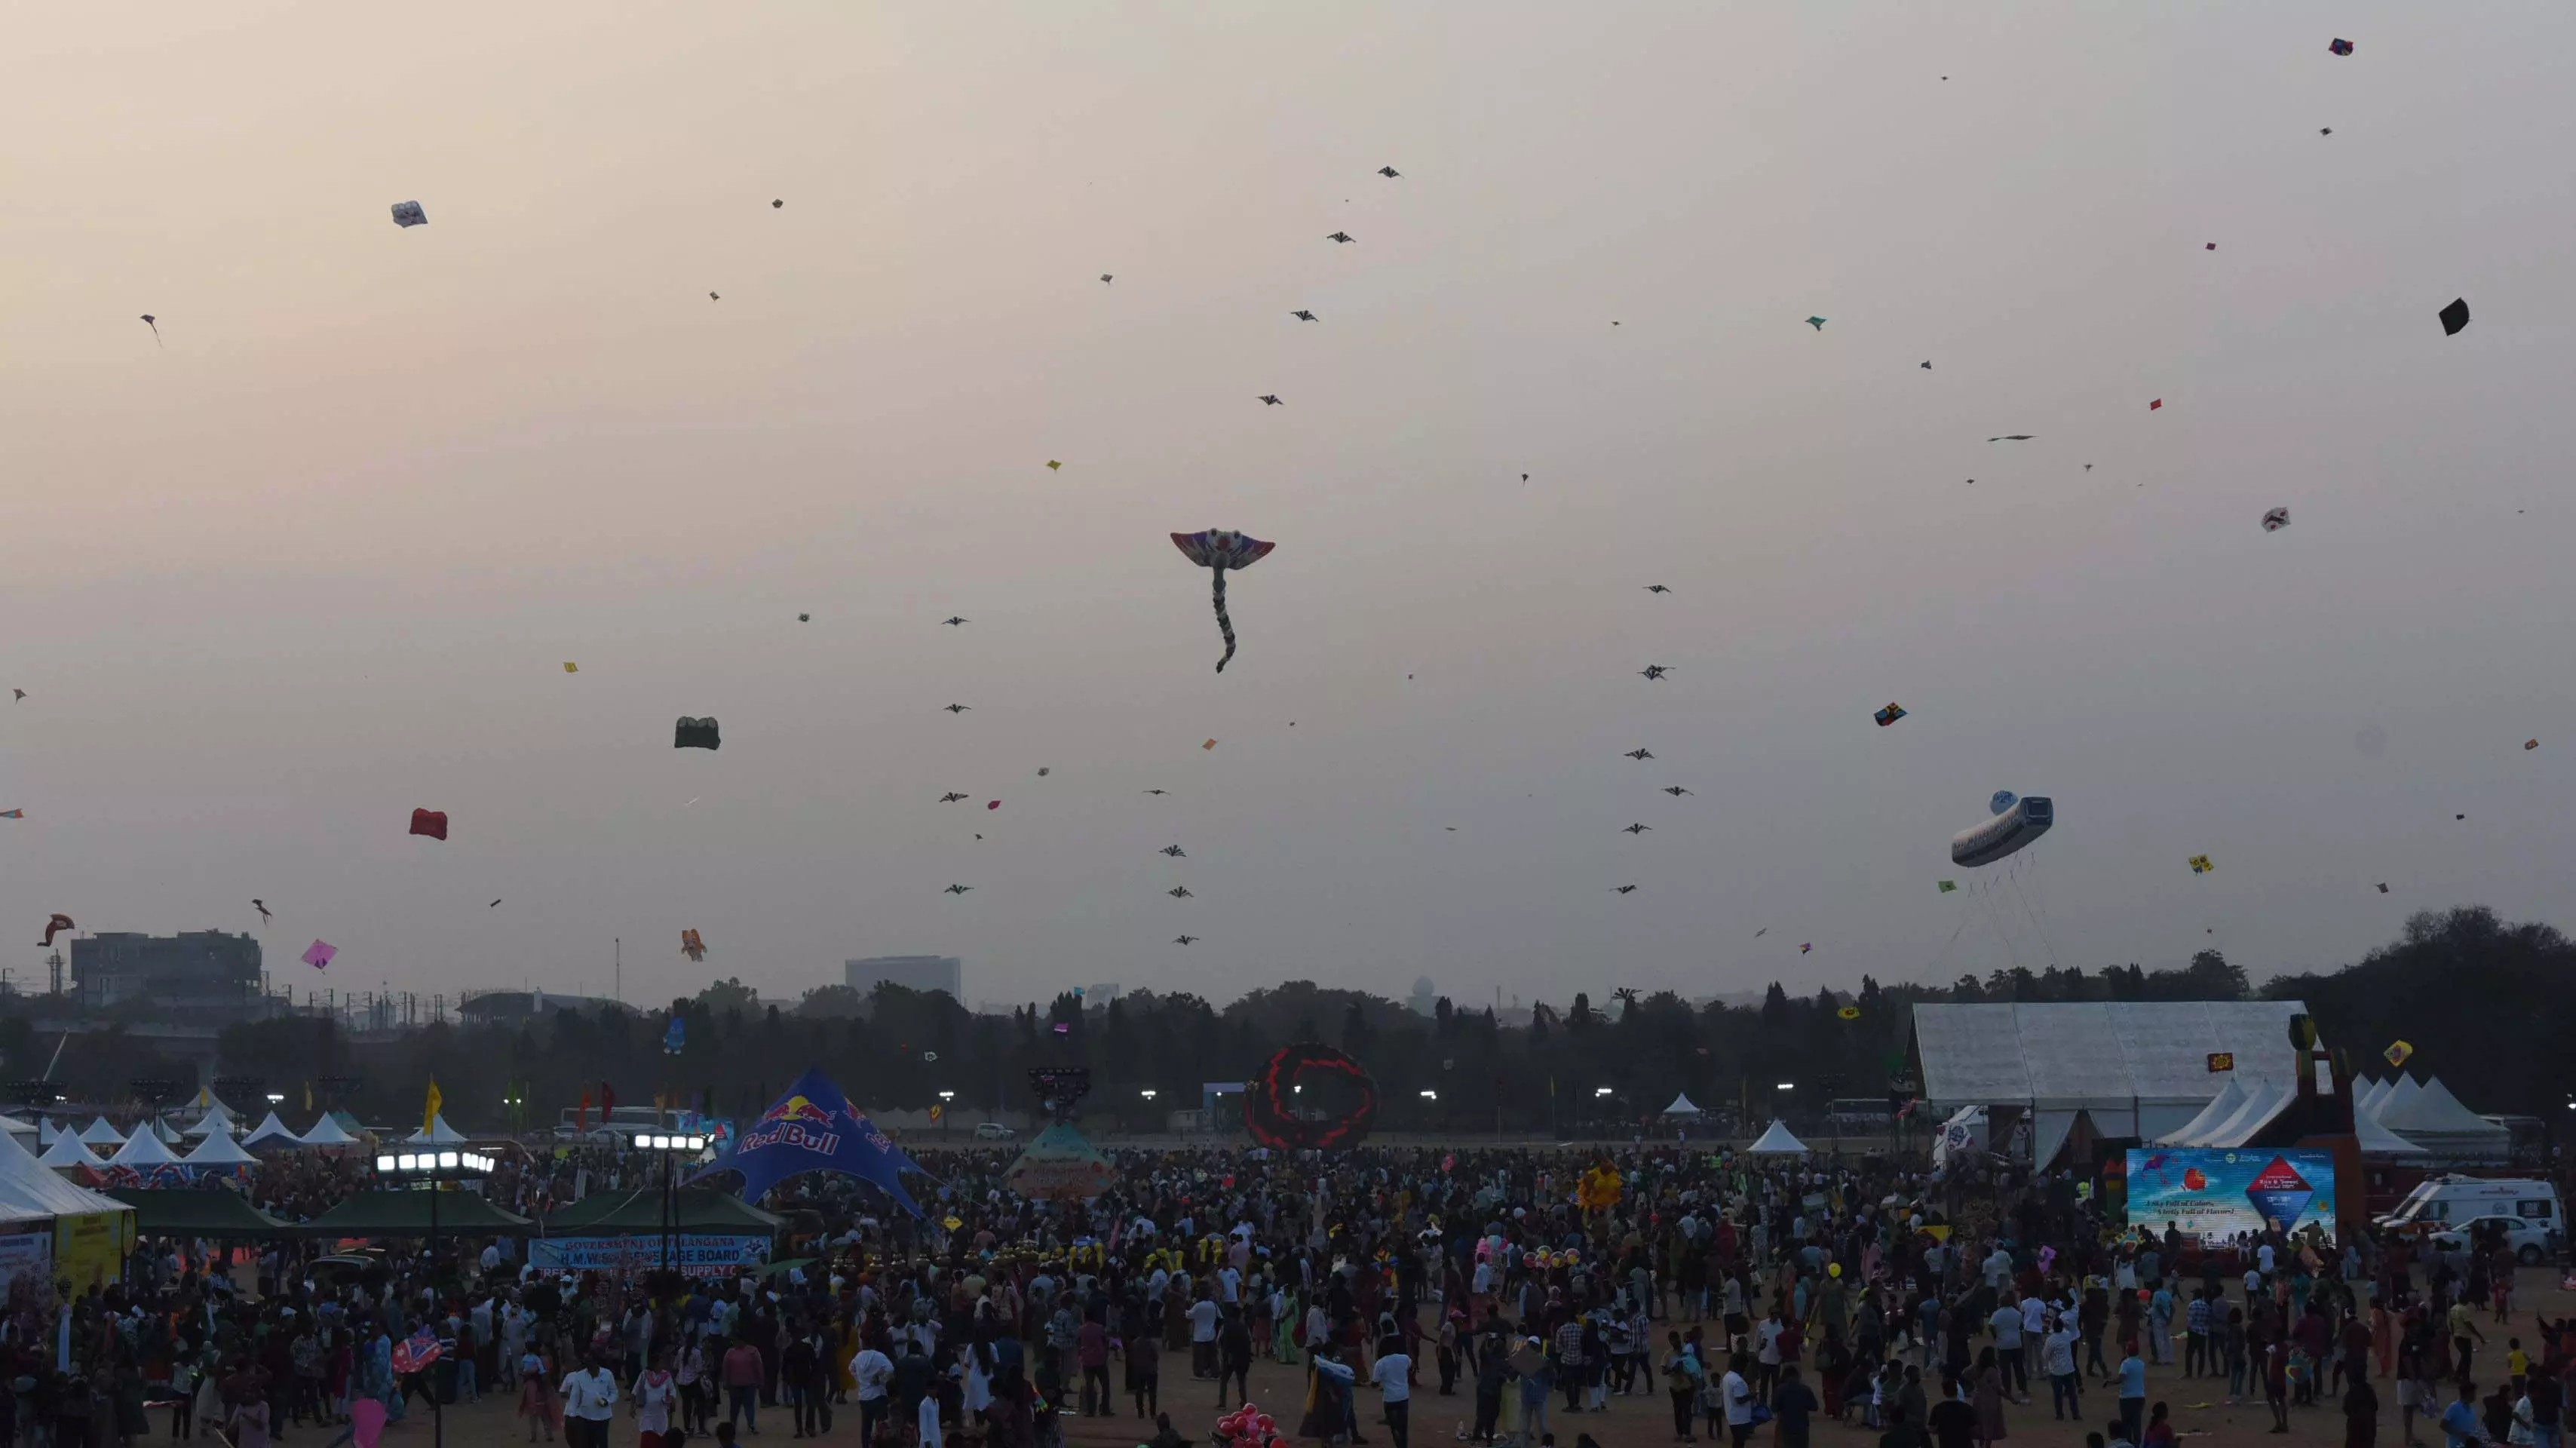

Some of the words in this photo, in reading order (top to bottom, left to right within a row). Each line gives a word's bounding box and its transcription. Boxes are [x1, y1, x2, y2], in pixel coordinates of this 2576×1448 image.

[737, 1122, 787, 1155] Red
[781, 1123, 841, 1155] Bull
[698, 1249, 739, 1262] BOARD
[681, 1265, 725, 1276] SUPPLY
